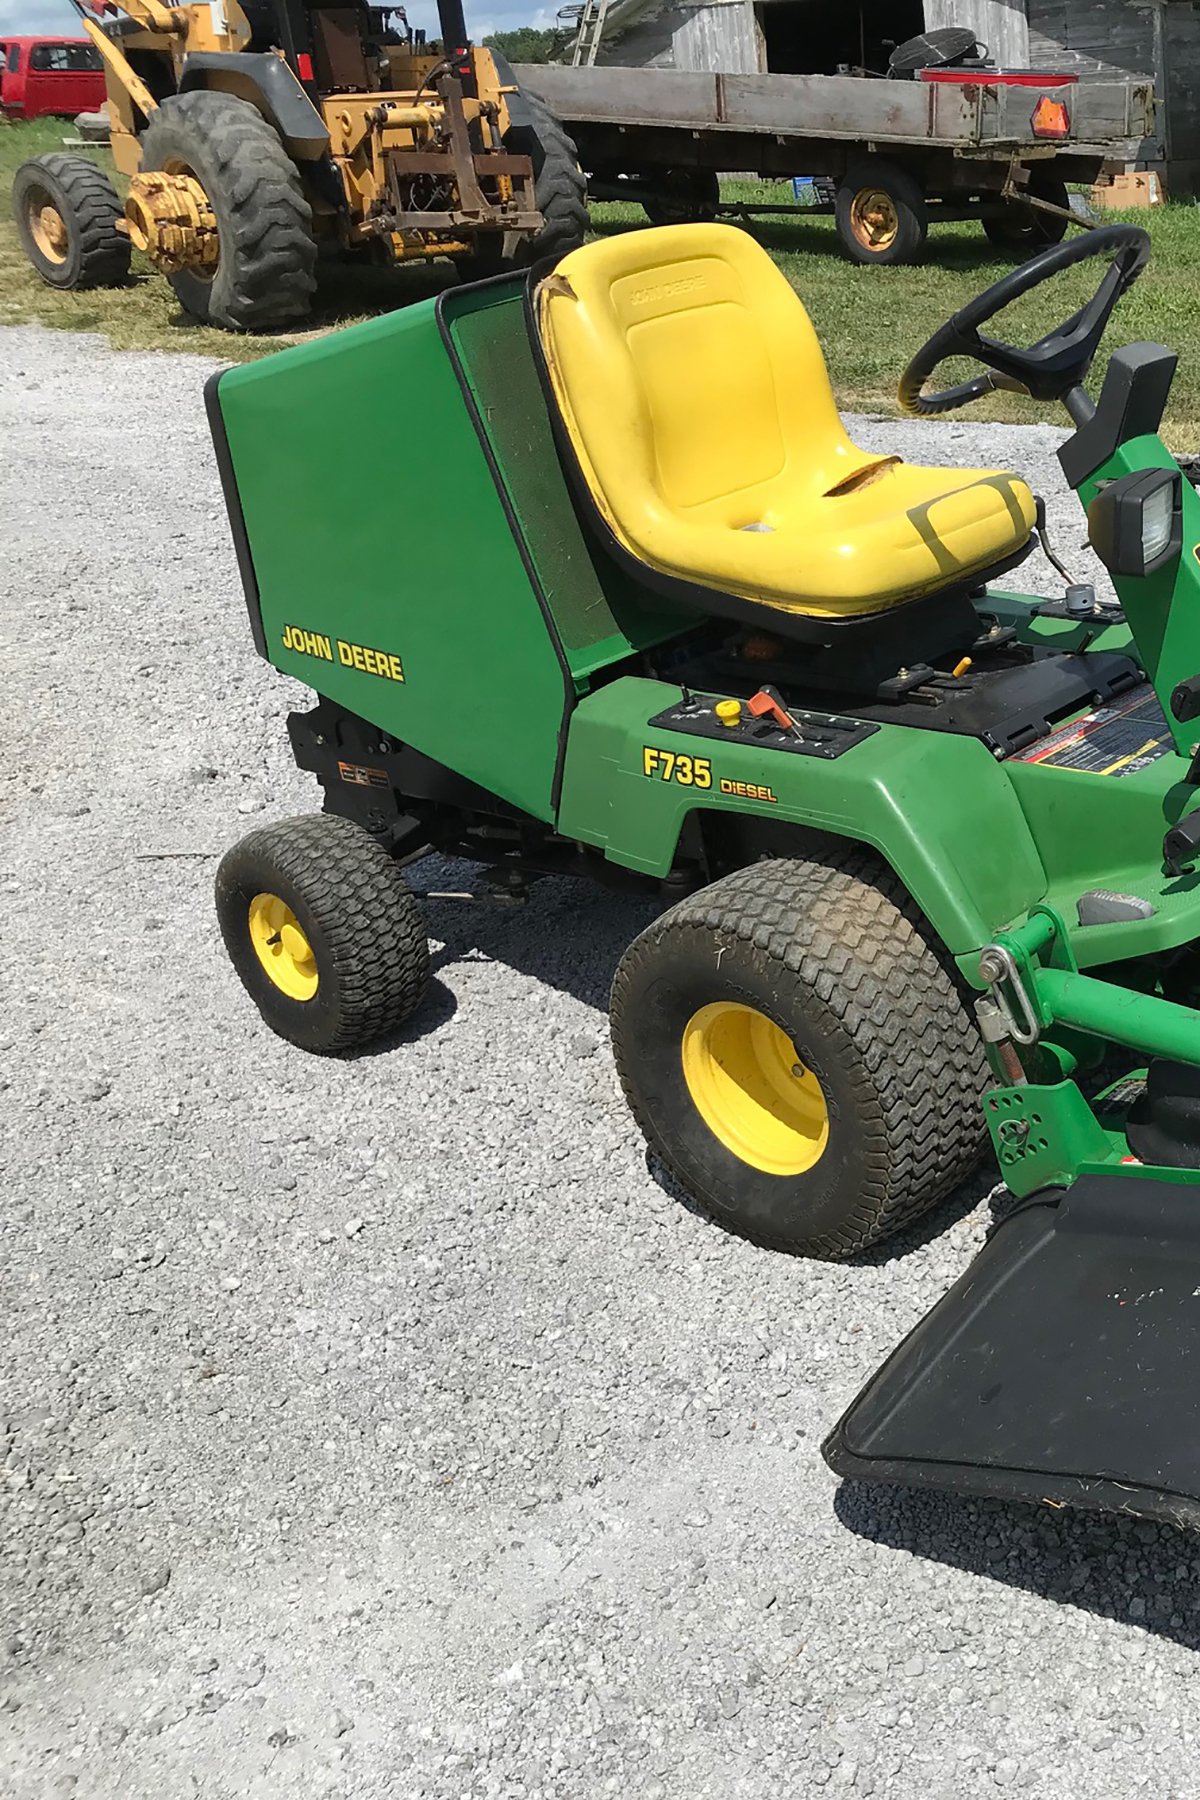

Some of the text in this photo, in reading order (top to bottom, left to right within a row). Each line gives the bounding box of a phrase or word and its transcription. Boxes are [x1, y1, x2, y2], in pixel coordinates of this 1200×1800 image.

[281, 623, 406, 684] JOHN DEERE
[643, 745, 712, 789] F735
